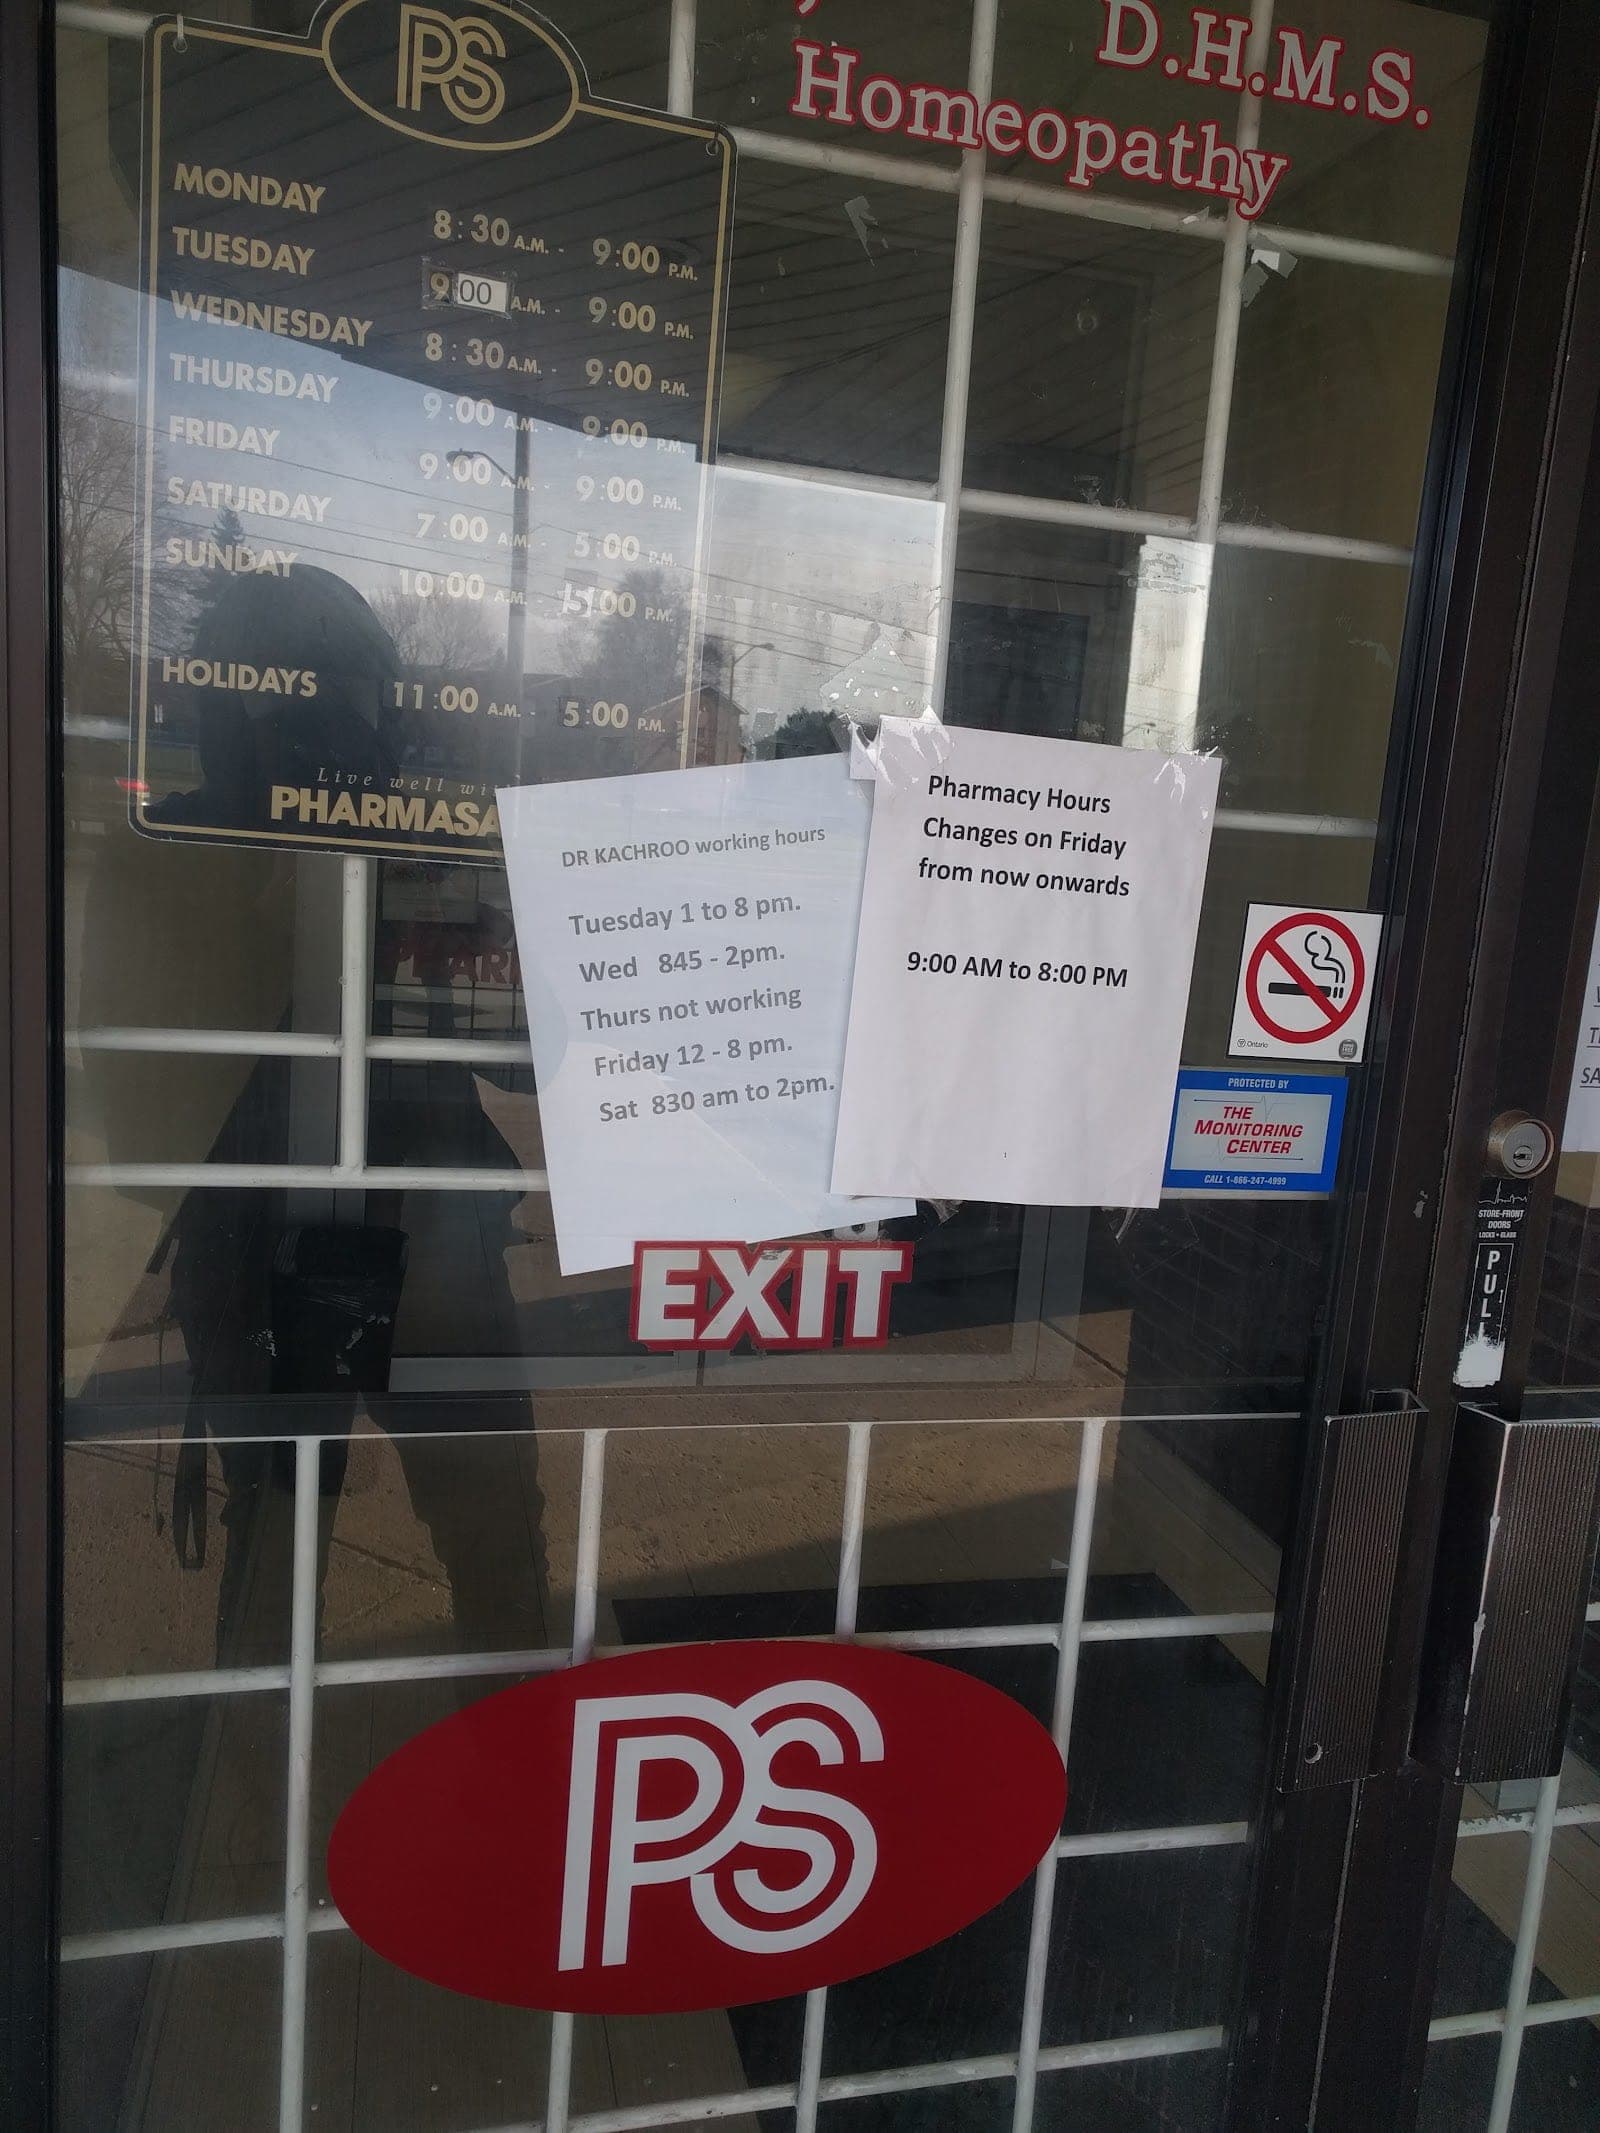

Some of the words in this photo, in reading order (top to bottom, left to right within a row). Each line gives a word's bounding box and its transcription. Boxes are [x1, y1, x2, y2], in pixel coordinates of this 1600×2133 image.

[397, 3, 506, 125] PS
[1099, 0, 1431, 129] D.H.M.S.
[791, 40, 1289, 218] Homeopathy
[173, 163, 326, 214] MONDAY
[433, 209, 510, 246] 8:30
[513, 235, 549, 254] A.M.
[592, 238, 660, 273] 9:00
[668, 262, 698, 281] P.M.
[172, 226, 316, 276] TUESDAY
[510, 296, 546, 315] A.M.
[588, 296, 656, 333] 9:00
[664, 321, 694, 340] P.M.
[170, 290, 373, 347] WEDNESDAY
[425, 332, 504, 369] 8:30
[507, 356, 542, 375] A.M.
[585, 358, 652, 391] 9:00
[660, 380, 690, 397] P.M.
[169, 352, 339, 404] THURSDAY
[423, 392, 495, 427] 9:00
[504, 415, 538, 433] A.M.
[582, 415, 648, 449] 9:00
[656, 438, 687, 455] P.M.
[169, 415, 280, 456] FRIDAY
[418, 452, 492, 486] 9:00
[500, 473, 535, 492] A.M.
[575, 475, 644, 506] 9:00
[652, 494, 683, 512] P.M.
[167, 476, 332, 522] SATURDAY
[415, 512, 489, 543] 7:00
[497, 533, 531, 549] A.M.
[574, 531, 641, 562] 5:00
[648, 551, 678, 567] P.M.
[165, 537, 299, 578] SUNDAY
[399, 568, 485, 600] 10:00
[494, 590, 528, 606] A.M.
[644, 606, 675, 623] P.M.
[162, 657, 318, 698] HOLIDAYS
[393, 681, 479, 714] 11:00
[487, 702, 521, 718] A.M.
[562, 700, 629, 729] 5:00
[637, 718, 666, 733] P.M.
[318, 767, 373, 786] Live
[390, 777, 444, 793] well
[928, 775, 1041, 811] Pharmacy
[1047, 788, 1111, 814] Hours
[561, 849, 590, 868] DR
[595, 839, 690, 865] KACHROO
[695, 832, 770, 854] working
[775, 828, 826, 846] hours
[923, 817, 1018, 848] Changes
[1024, 831, 1052, 849] on
[1059, 830, 1127, 860] Friday
[918, 857, 973, 882] from
[980, 867, 1031, 887] now
[1036, 873, 1130, 897] onwards
[568, 907, 673, 938] Tuesday
[681, 902, 695, 924] 1
[701, 900, 728, 921] to
[734, 896, 749, 918] 8
[755, 895, 802, 920] pm.
[579, 955, 638, 983] Wed
[658, 949, 702, 975] 845
[725, 944, 786, 969] 2pm.
[907, 951, 957, 975] 9:00
[962, 956, 1003, 978] AM
[1009, 960, 1031, 980] to
[1037, 962, 1087, 985] 8:00
[1092, 966, 1128, 988] PM
[580, 1006, 651, 1031] Thurs
[658, 999, 699, 1022] not
[705, 987, 802, 1015] working
[594, 1049, 670, 1077] Friday
[676, 1043, 705, 1066] 12
[727, 1038, 742, 1059] 8
[748, 1036, 793, 1060] pm.
[599, 1100, 638, 1123] Sat
[651, 1091, 696, 1115] 830
[702, 1088, 739, 1109] am
[745, 1083, 770, 1103] to
[776, 1076, 835, 1100] 2pm.
[1228, 1077, 1276, 1088] PROTECTED
[1278, 1079, 1290, 1089] BY
[1194, 1119, 1304, 1138] MONITORING
[1223, 1106, 1254, 1120] THE
[1226, 1139, 1292, 1154] CENTER
[1204, 1174, 1224, 1184] CALL
[1478, 1209, 1524, 1221] STORE-FRONT
[1488, 1220, 1511, 1229] DOORS
[634, 1245, 909, 1346] EXIT
[558, 1679, 885, 1972] PS
